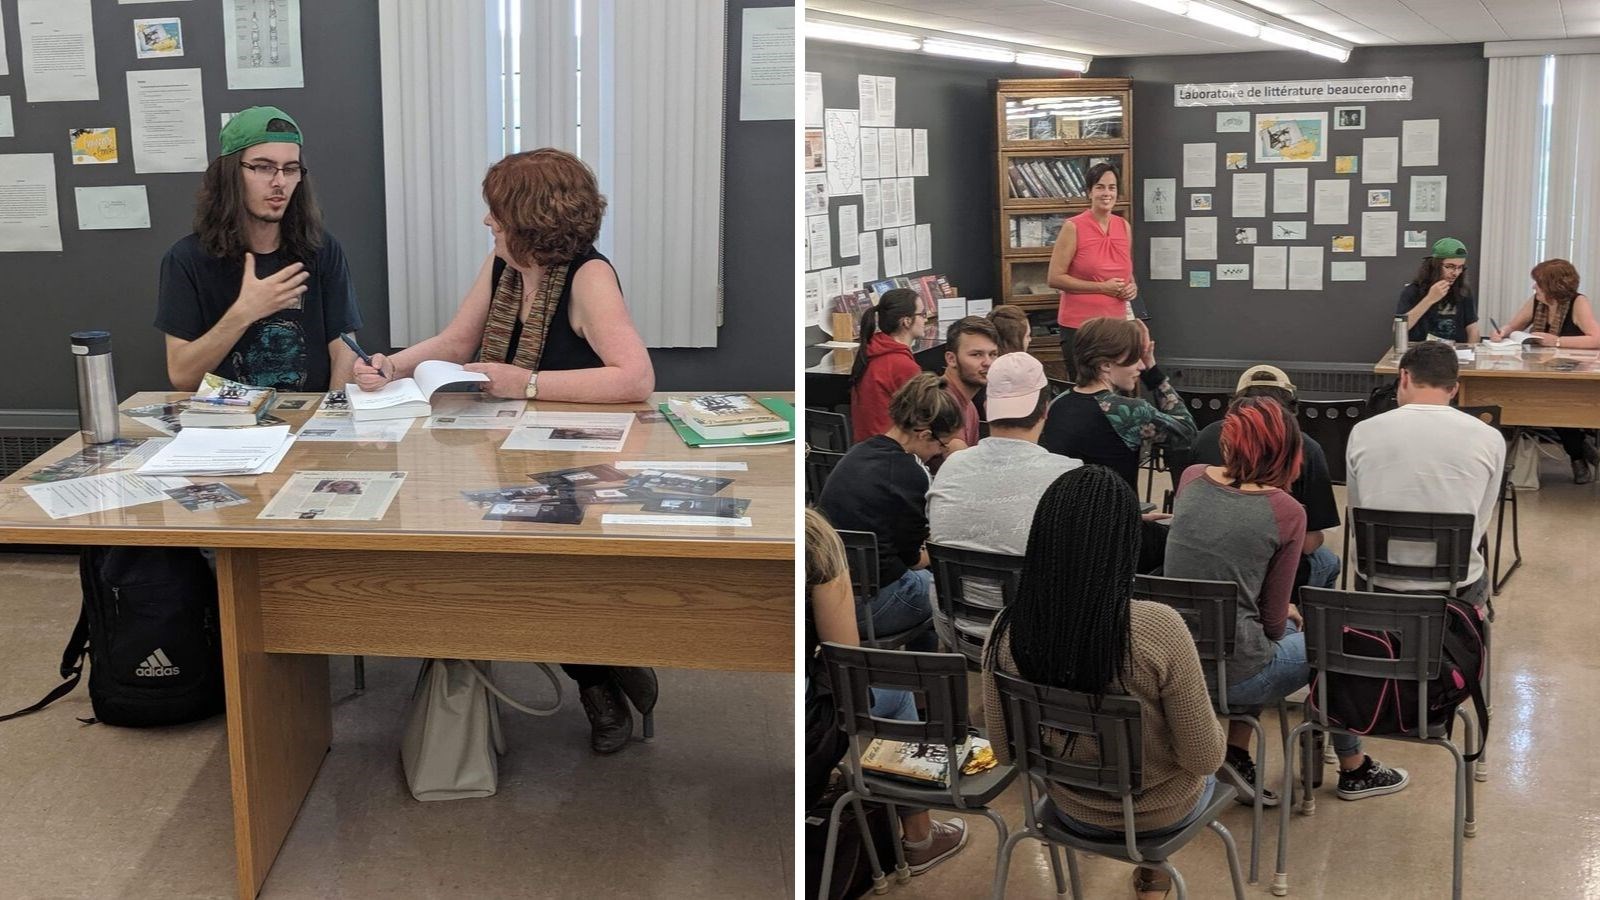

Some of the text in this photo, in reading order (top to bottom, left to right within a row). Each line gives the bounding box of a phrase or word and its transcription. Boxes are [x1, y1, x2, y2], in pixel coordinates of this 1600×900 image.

[1179, 84, 1407, 100] Laboratoire de littérature beauceronne
[136, 666, 180, 676] adidas
